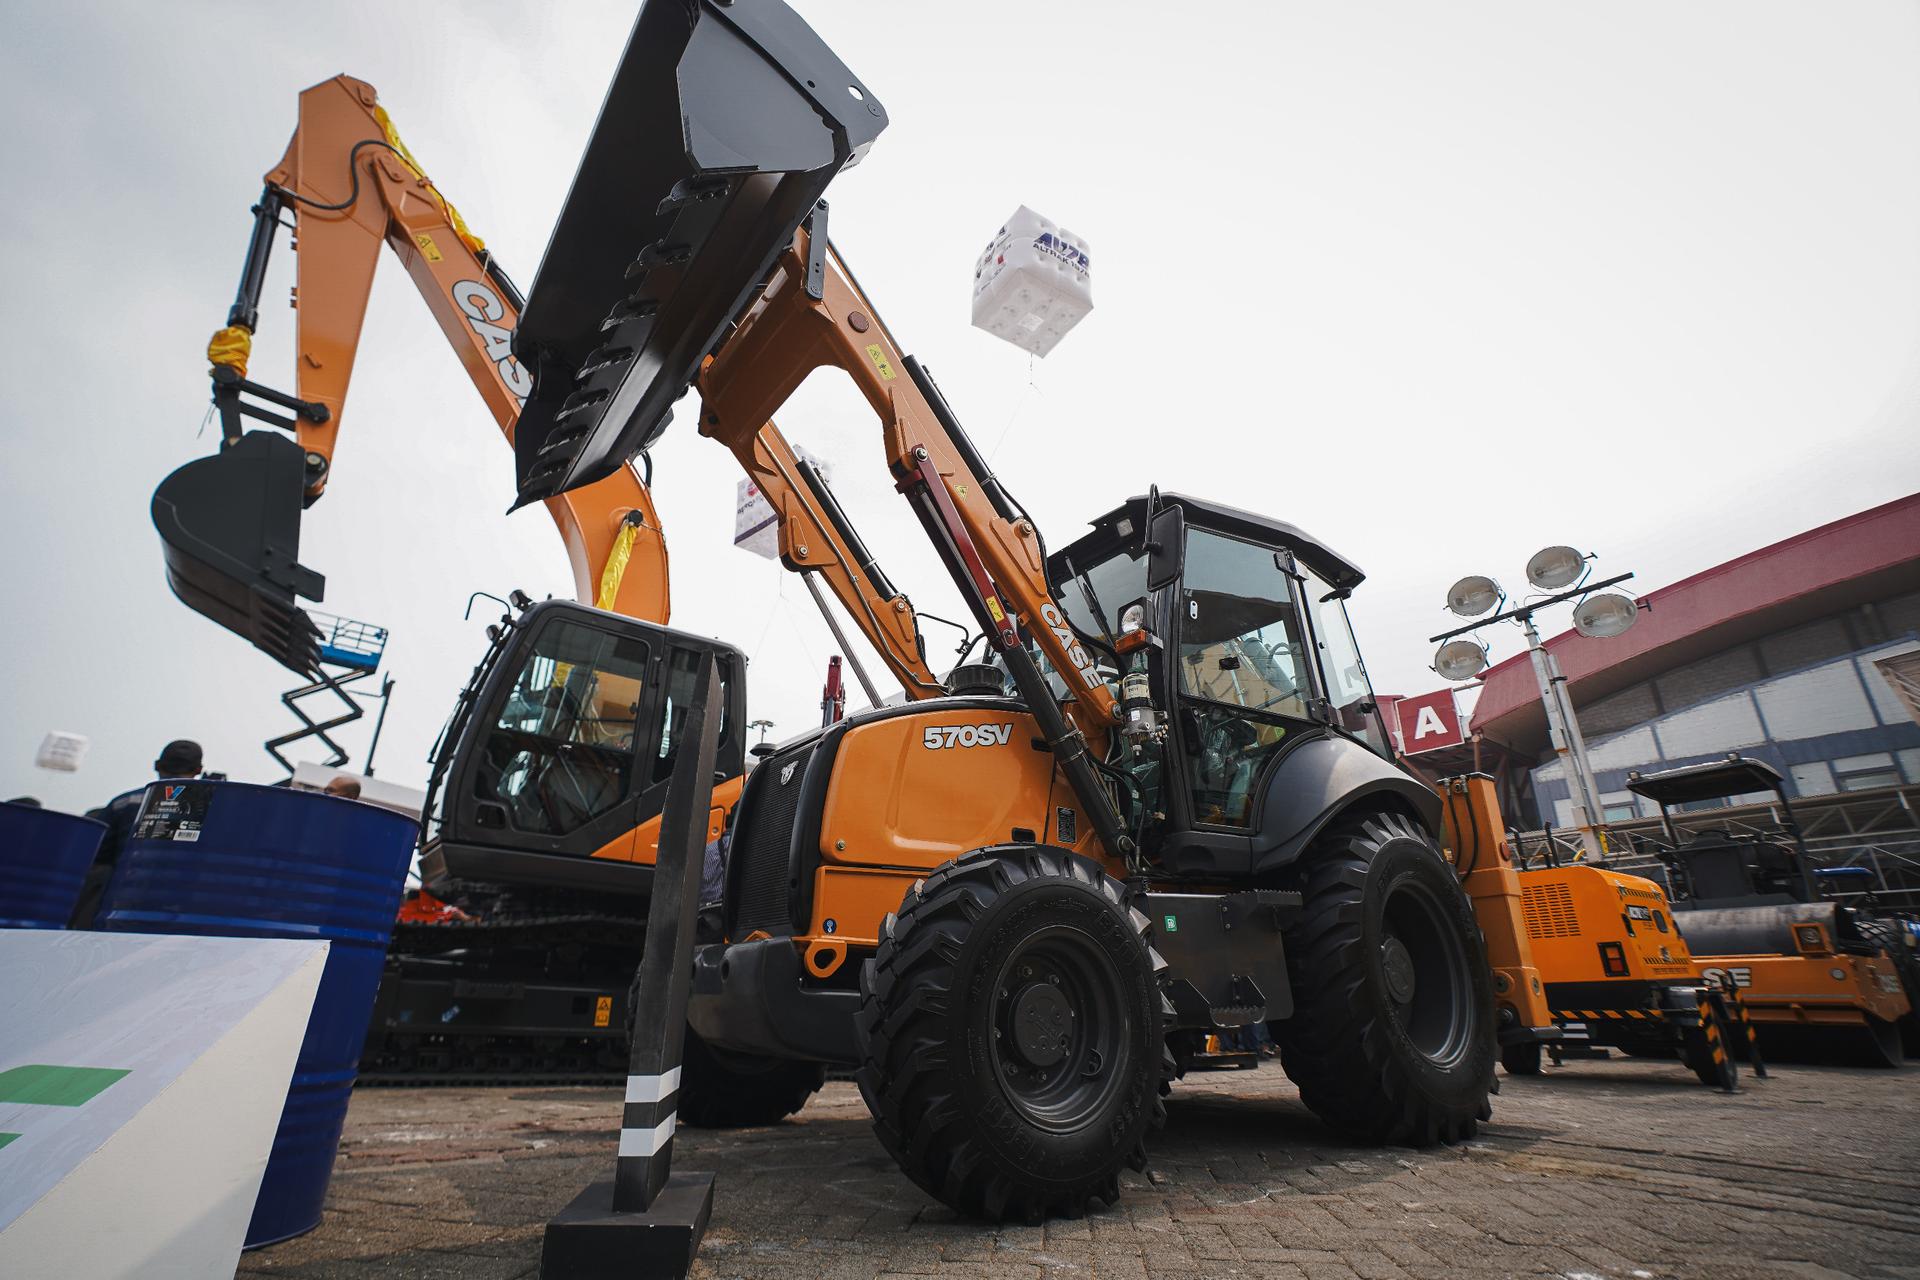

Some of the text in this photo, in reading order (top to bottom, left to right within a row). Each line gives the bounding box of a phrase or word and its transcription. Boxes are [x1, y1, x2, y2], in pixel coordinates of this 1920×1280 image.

[452, 279, 534, 408] CAS
[1040, 603, 1104, 690] CASE
[923, 723, 1013, 750] 570SV
[1414, 706, 1448, 740] A
[1701, 967, 1752, 988] SE
